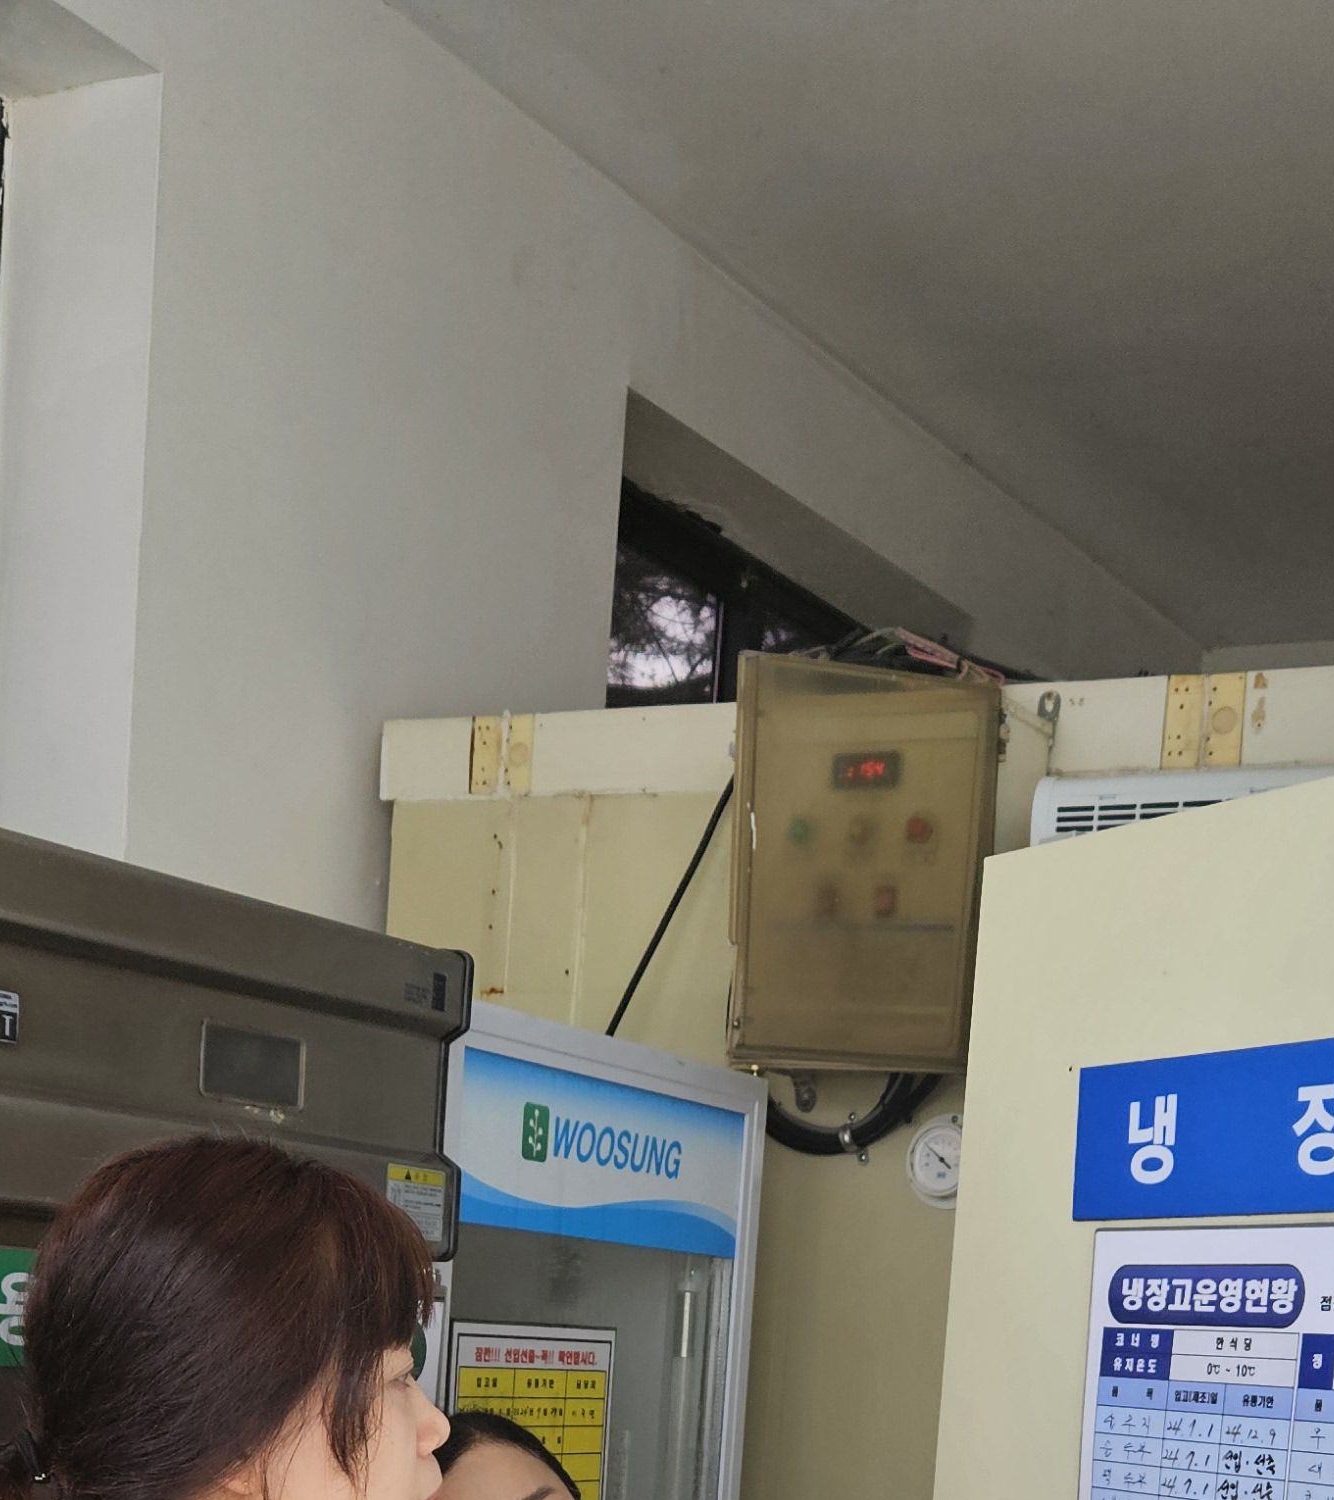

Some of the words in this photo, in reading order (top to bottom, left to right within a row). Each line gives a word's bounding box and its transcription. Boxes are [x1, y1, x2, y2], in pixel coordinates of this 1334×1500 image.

[552, 1115, 683, 1181] WOOSUNG
[1122, 1277, 1299, 1315] 냉장고운영현황
[1114, 1332, 1160, 1348] 코너명
[1112, 1357, 1158, 1374] 유지온도
